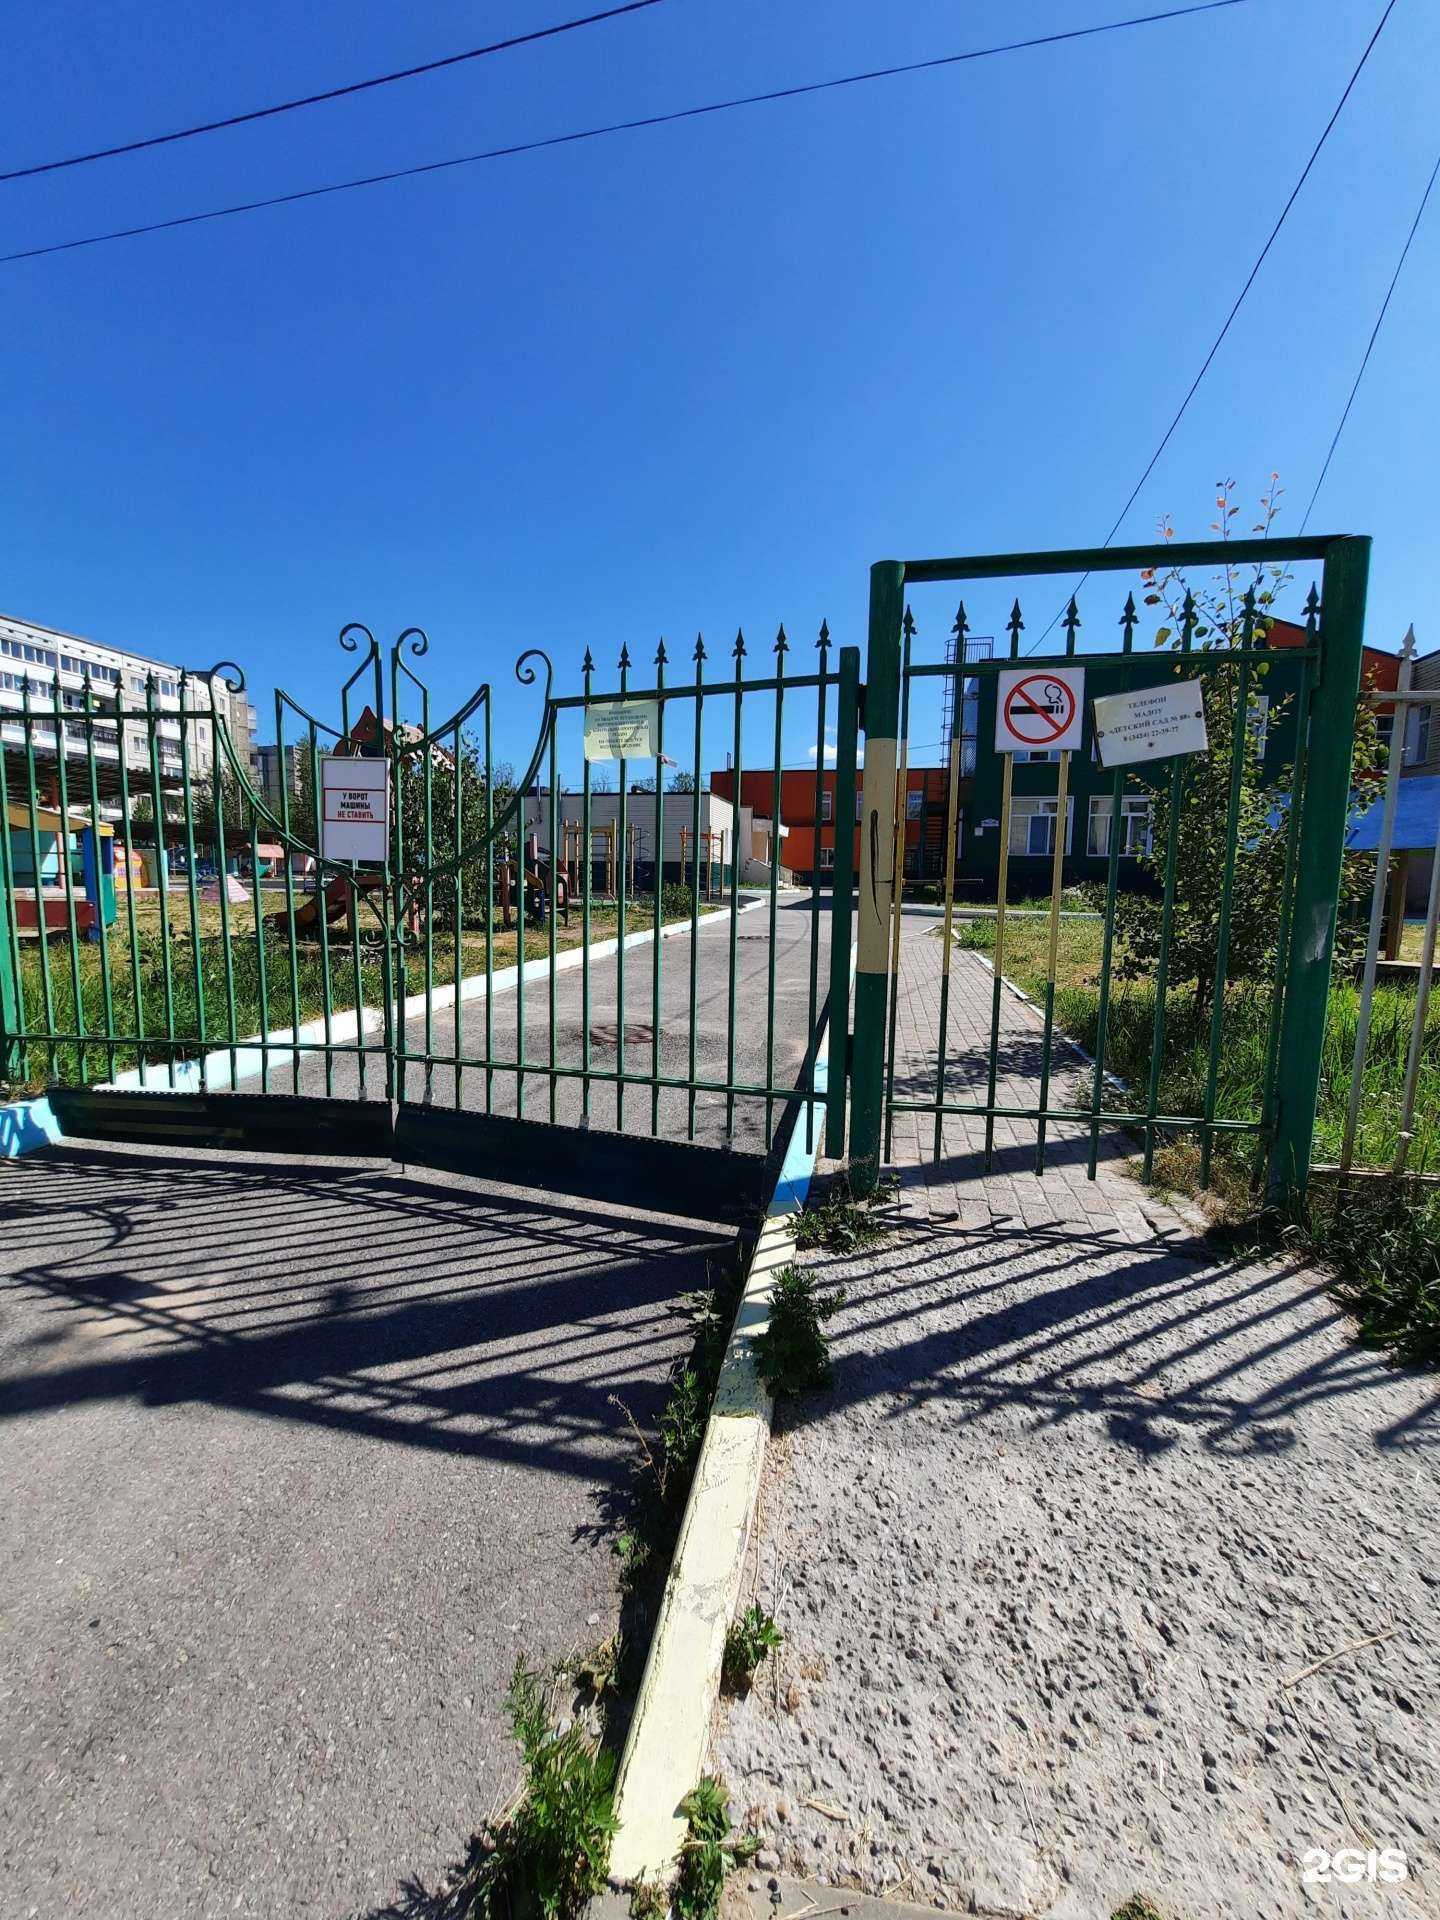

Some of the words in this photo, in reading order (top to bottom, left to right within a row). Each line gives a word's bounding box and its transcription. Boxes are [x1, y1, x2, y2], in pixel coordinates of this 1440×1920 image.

[342, 792, 347, 800] У
[348, 792, 369, 801] ВОРОТ
[340, 801, 371, 810] МАШИНЫ
[337, 810, 347, 818] НЕ
[347, 810, 374, 819] СТАВИТЬ
